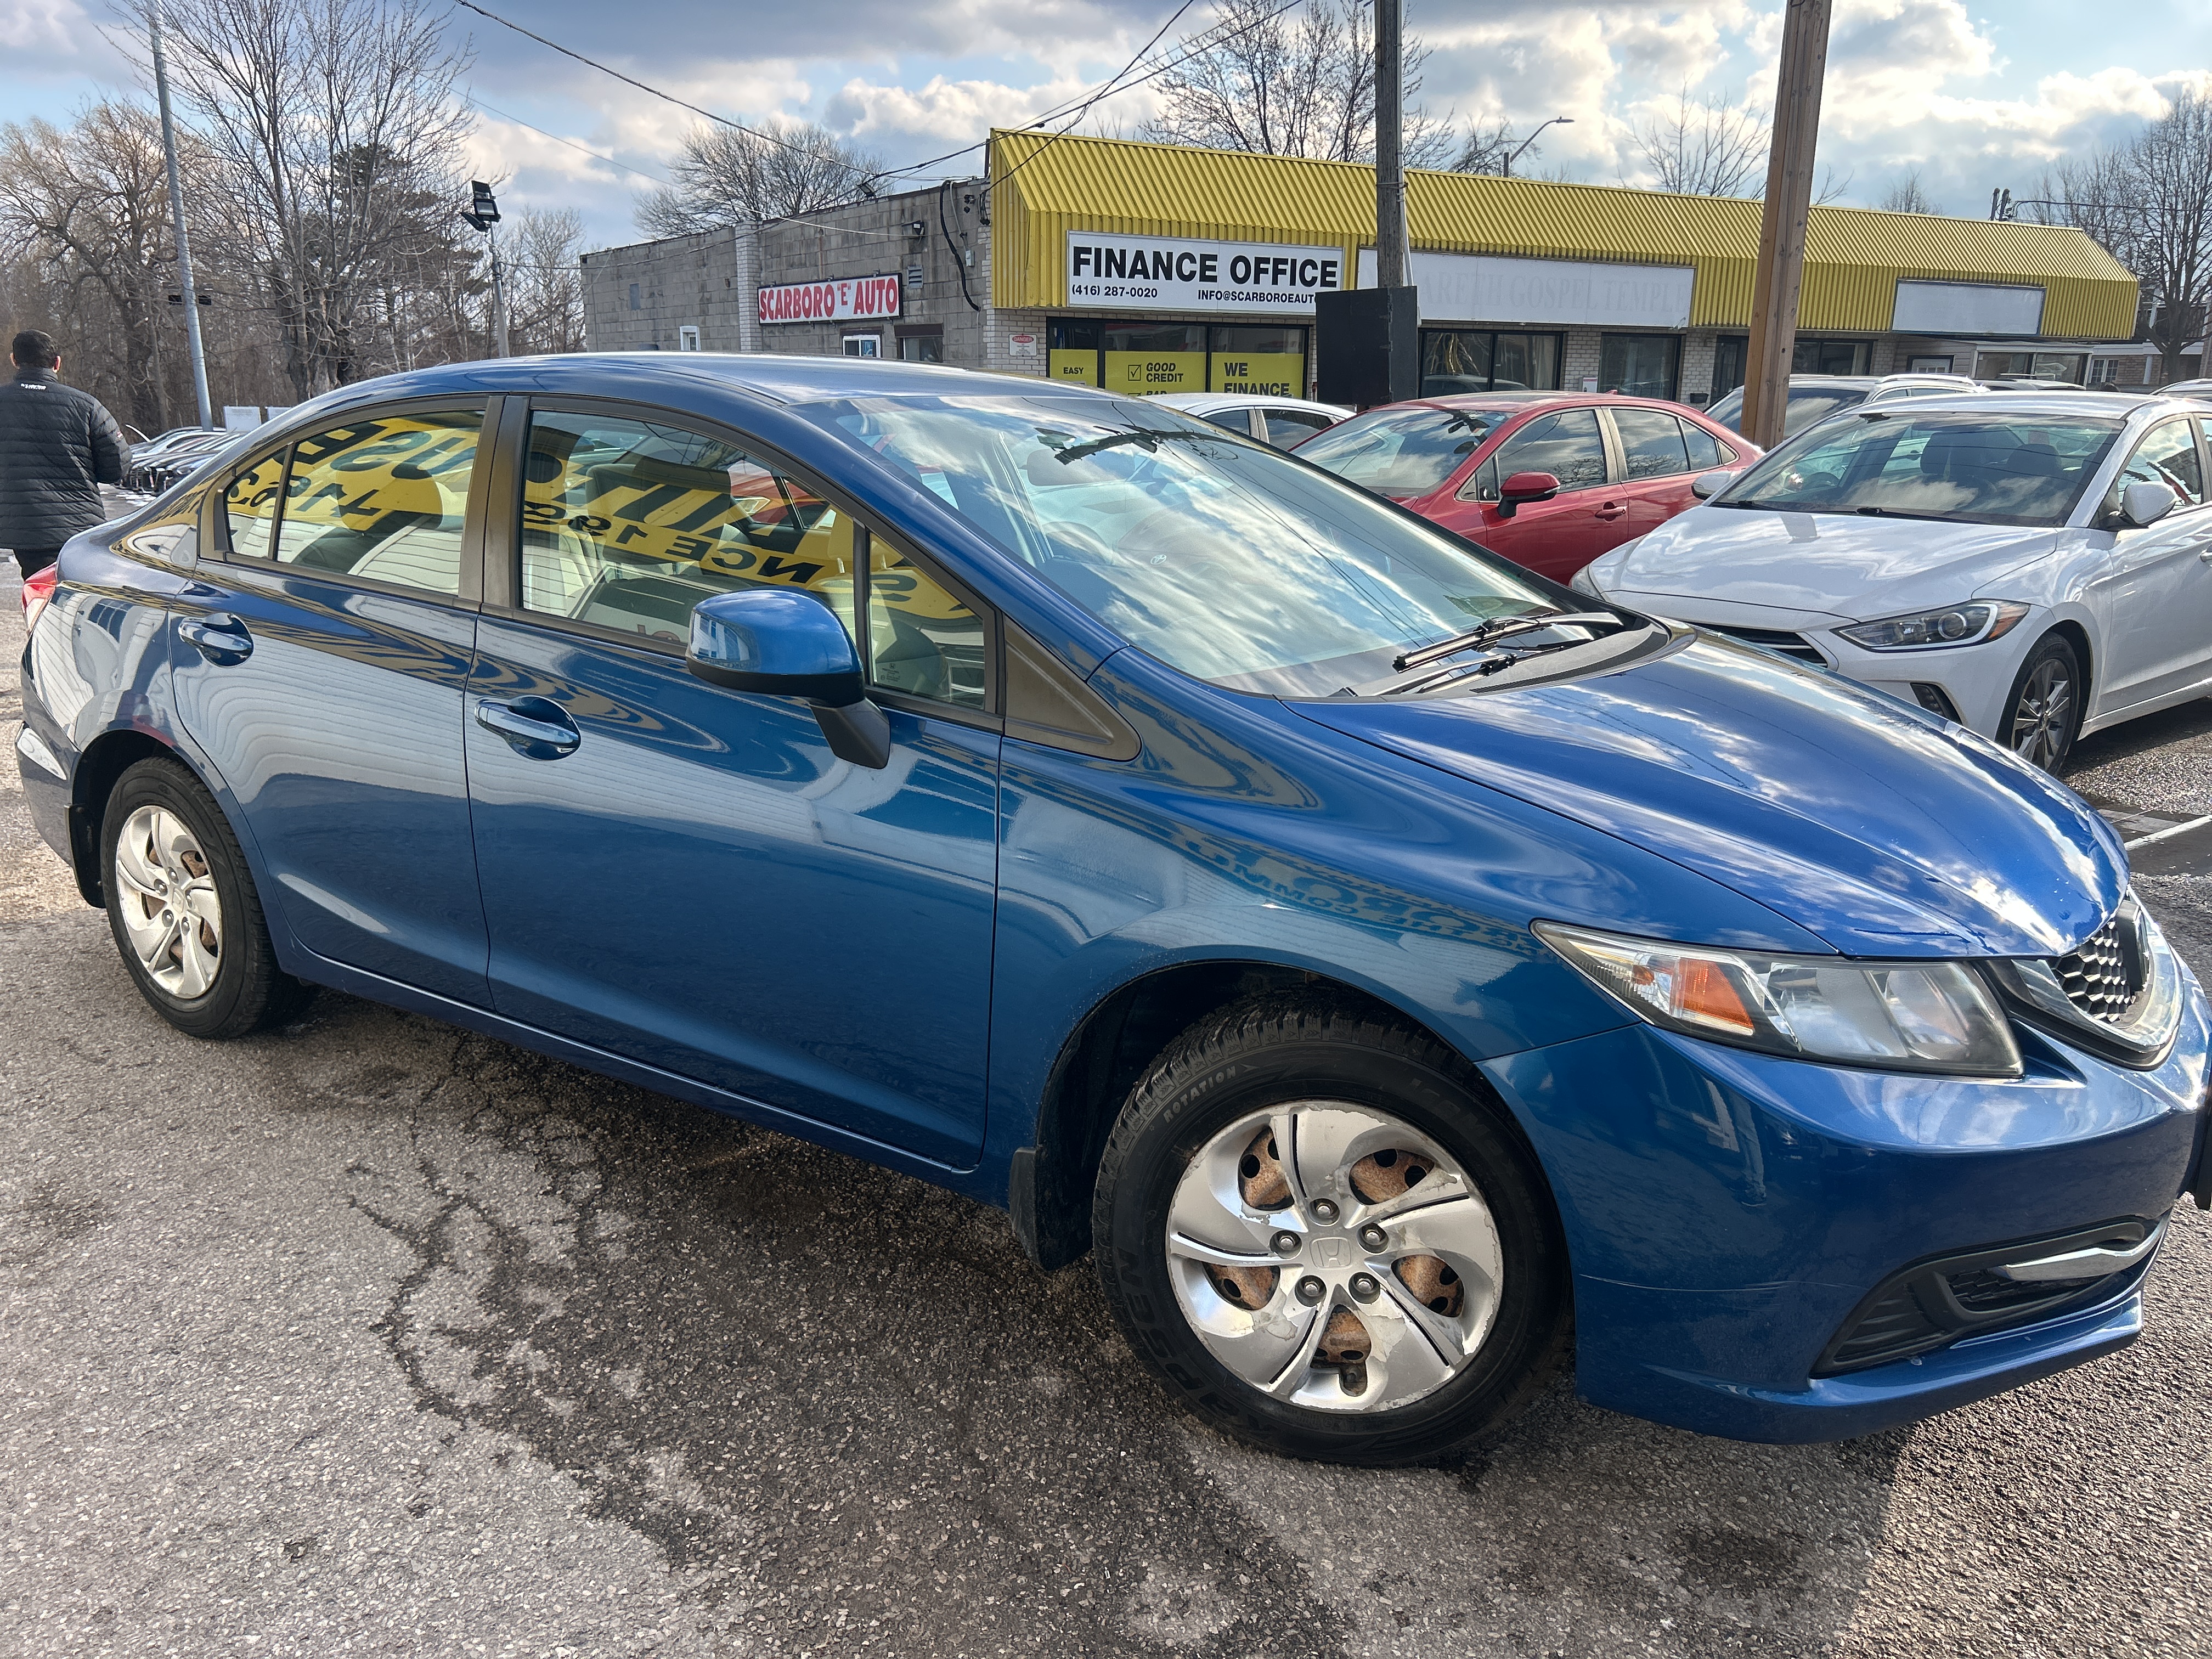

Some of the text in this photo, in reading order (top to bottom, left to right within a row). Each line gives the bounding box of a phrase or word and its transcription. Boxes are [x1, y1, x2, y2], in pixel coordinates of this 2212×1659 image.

[1073, 246, 1339, 288] FINANCE OFFICE
[760, 284, 836, 321] SCARBORO
[854, 277, 898, 315] AUTO
[1072, 285, 1316, 304] (416) 287-0020 INFO@SCARBOROEAUT
[1063, 366, 1084, 375] EASY
[1146, 362, 1176, 373] GOOD
[1224, 362, 1248, 377] WE
[1146, 373, 1184, 383] CREDIT
[1224, 382, 1290, 397] FINANCE
[1163, 1065, 1236, 1124] ROTATION
